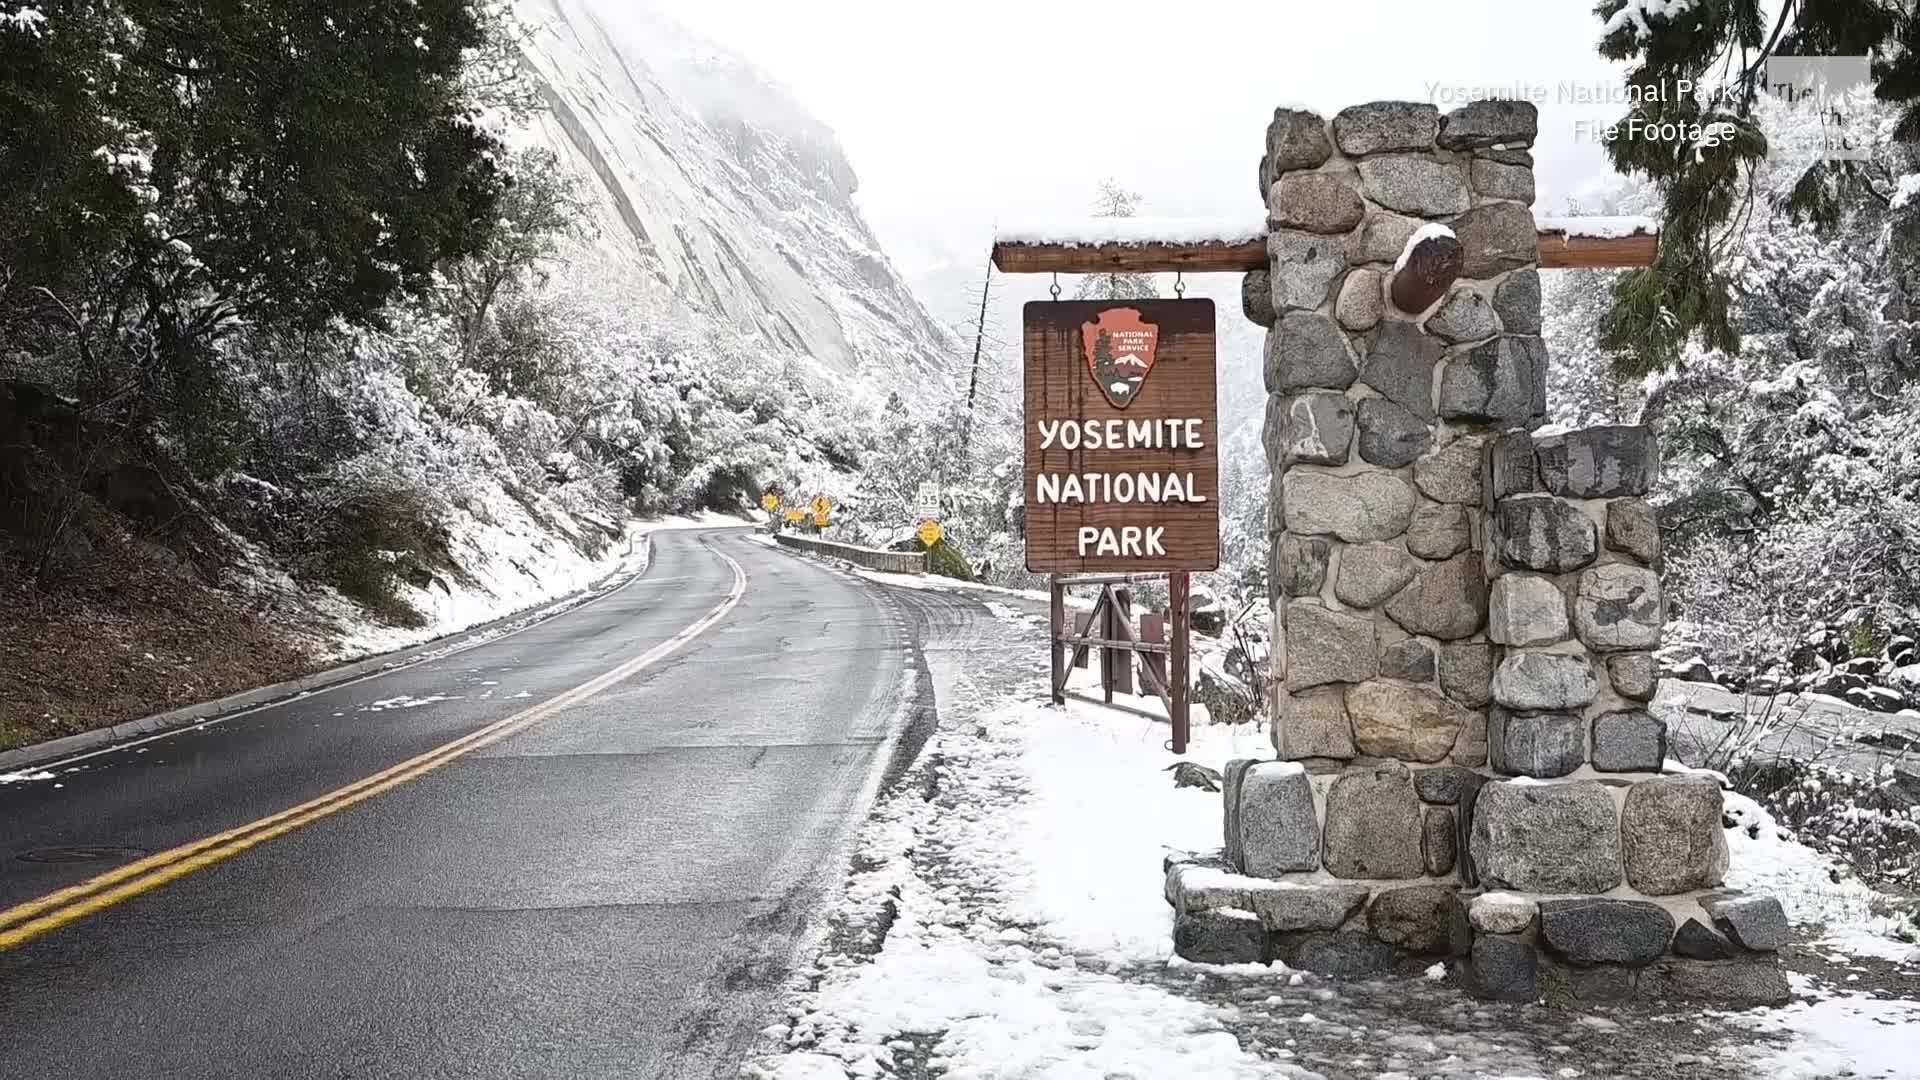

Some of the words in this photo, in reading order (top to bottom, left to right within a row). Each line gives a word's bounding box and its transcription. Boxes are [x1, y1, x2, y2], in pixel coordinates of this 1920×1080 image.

[1118, 344, 1149, 352] SERVICE
[1037, 418, 1204, 450] YOSEMITE
[921, 495, 937, 505] 35
[1036, 471, 1207, 504] NATIONAL
[1077, 526, 1166, 557] PARK
